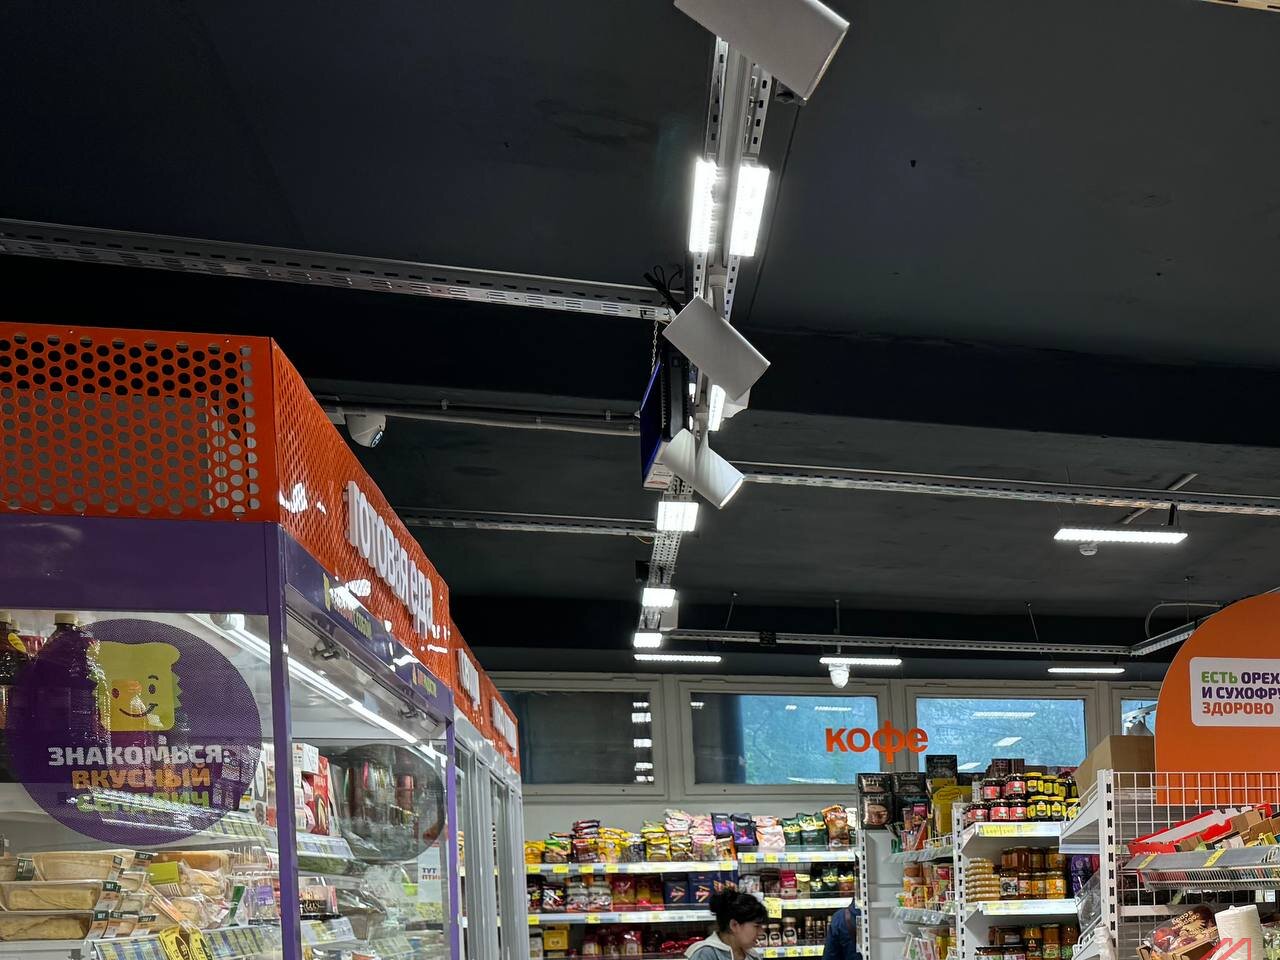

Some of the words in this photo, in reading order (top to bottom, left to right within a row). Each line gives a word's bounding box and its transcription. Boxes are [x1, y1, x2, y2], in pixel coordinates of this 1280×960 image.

[347, 480, 409, 606] готовая
[408, 559, 434, 639] еда
[1200, 671, 1238, 684] ЕСТЬ
[1201, 686, 1213, 699] И
[1202, 701, 1274, 717] ЗДОРОВО
[825, 720, 929, 765] кофе
[71, 762, 211, 789] ВКУСНЫЙ
[76, 791, 210, 813] СЕВИЧ
